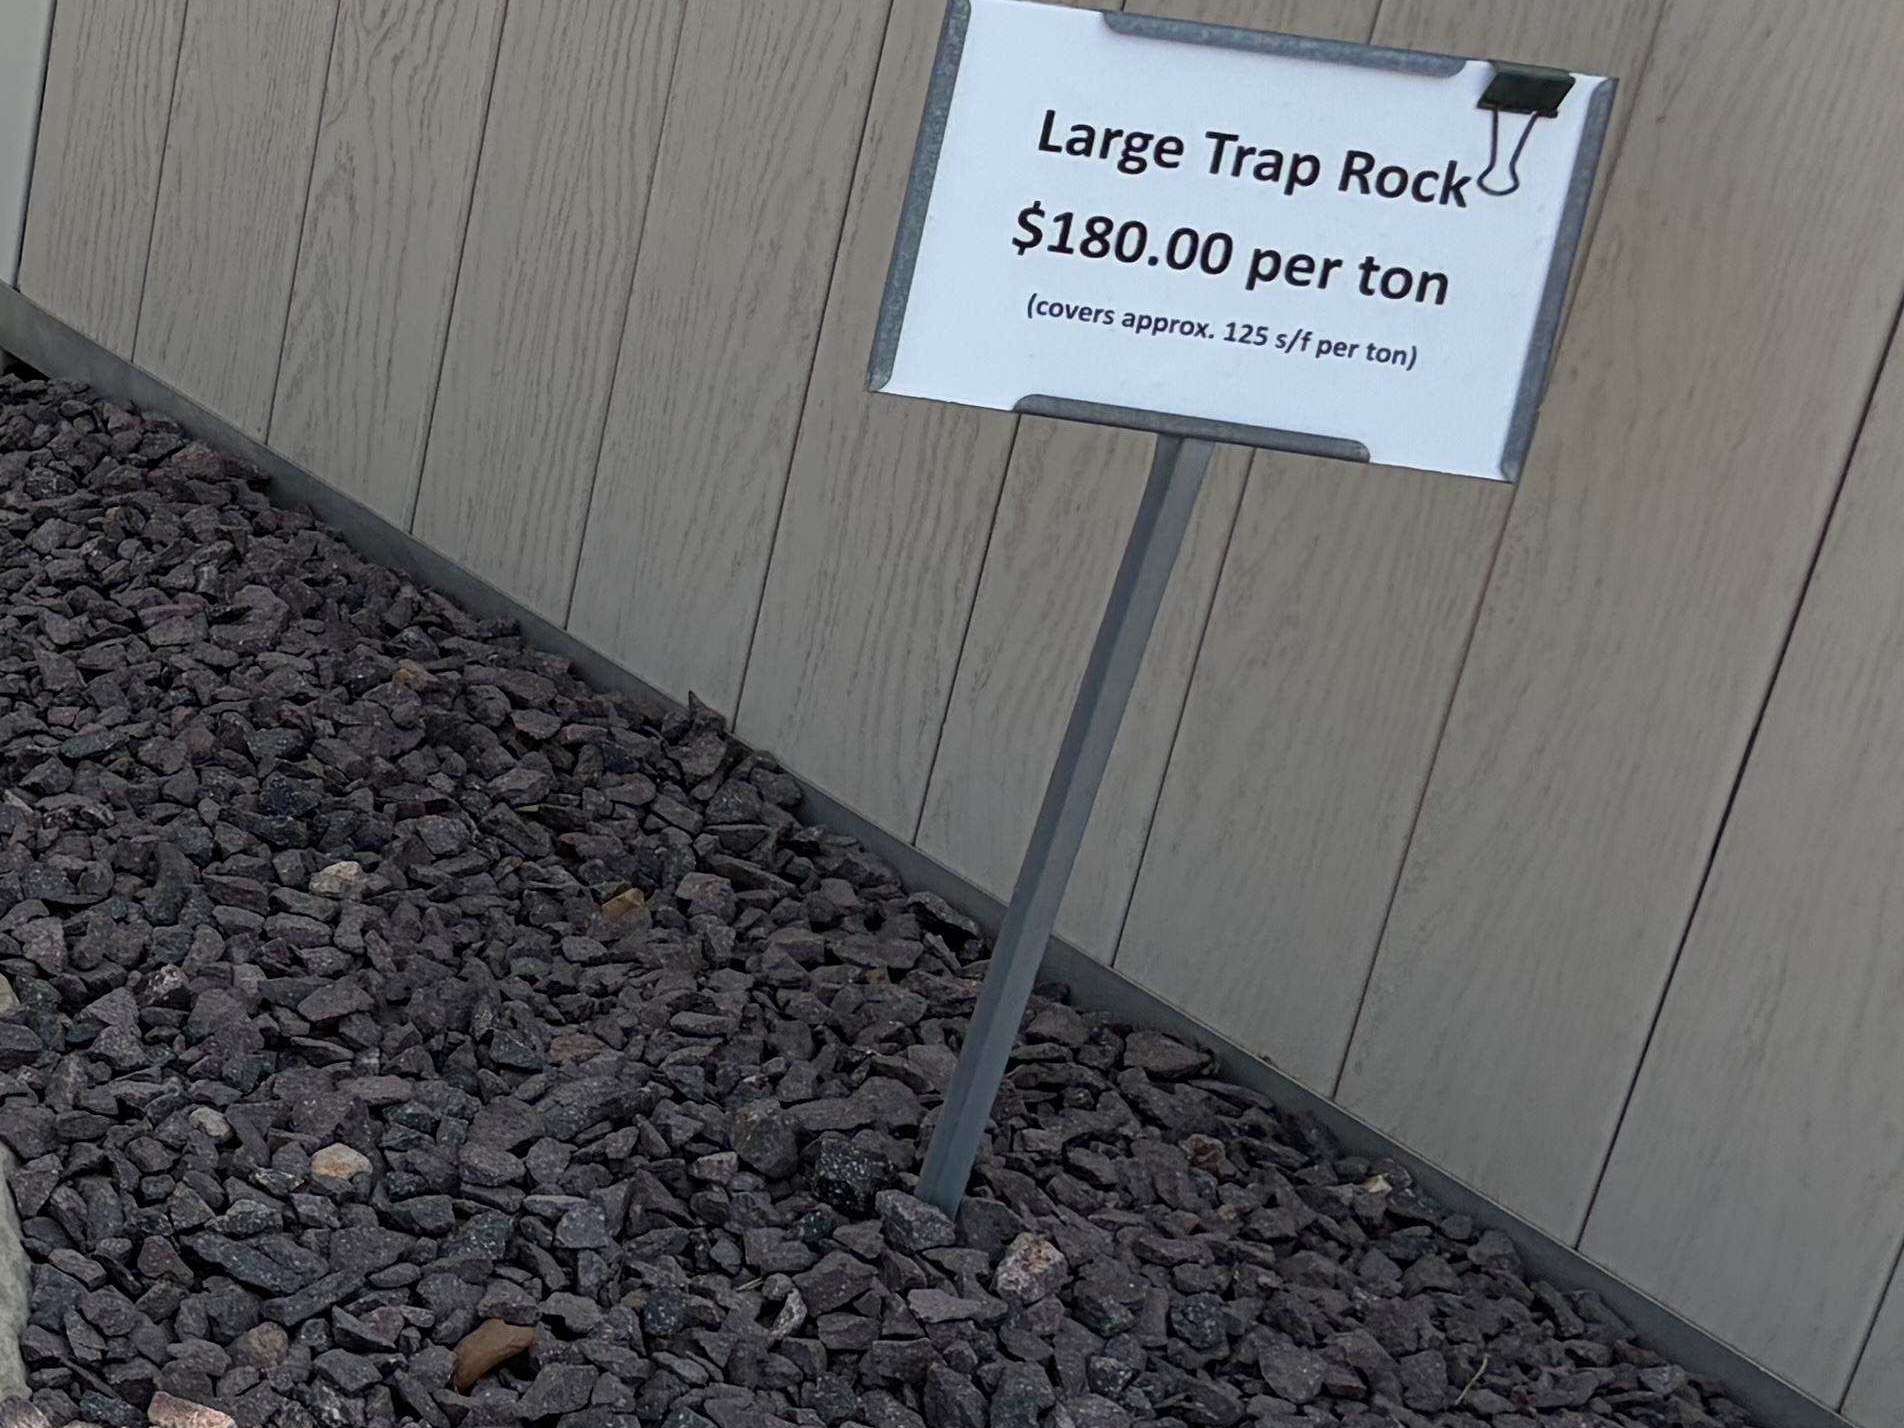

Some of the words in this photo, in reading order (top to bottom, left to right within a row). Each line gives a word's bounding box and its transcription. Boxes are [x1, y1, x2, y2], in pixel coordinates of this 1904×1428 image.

[1037, 109, 1185, 175] Large
[1204, 130, 1321, 197] Trap
[1337, 149, 1473, 209] Rock
[1011, 200, 1234, 275] $180.00
[1244, 248, 1344, 292] per
[1358, 255, 1449, 306] ton
[1027, 292, 1116, 326] (covers
[1121, 312, 1215, 340] approx.
[1223, 321, 1270, 347] 125
[1274, 328, 1314, 354] s/f
[1314, 339, 1361, 359] per
[1365, 342, 1418, 372] ton)
